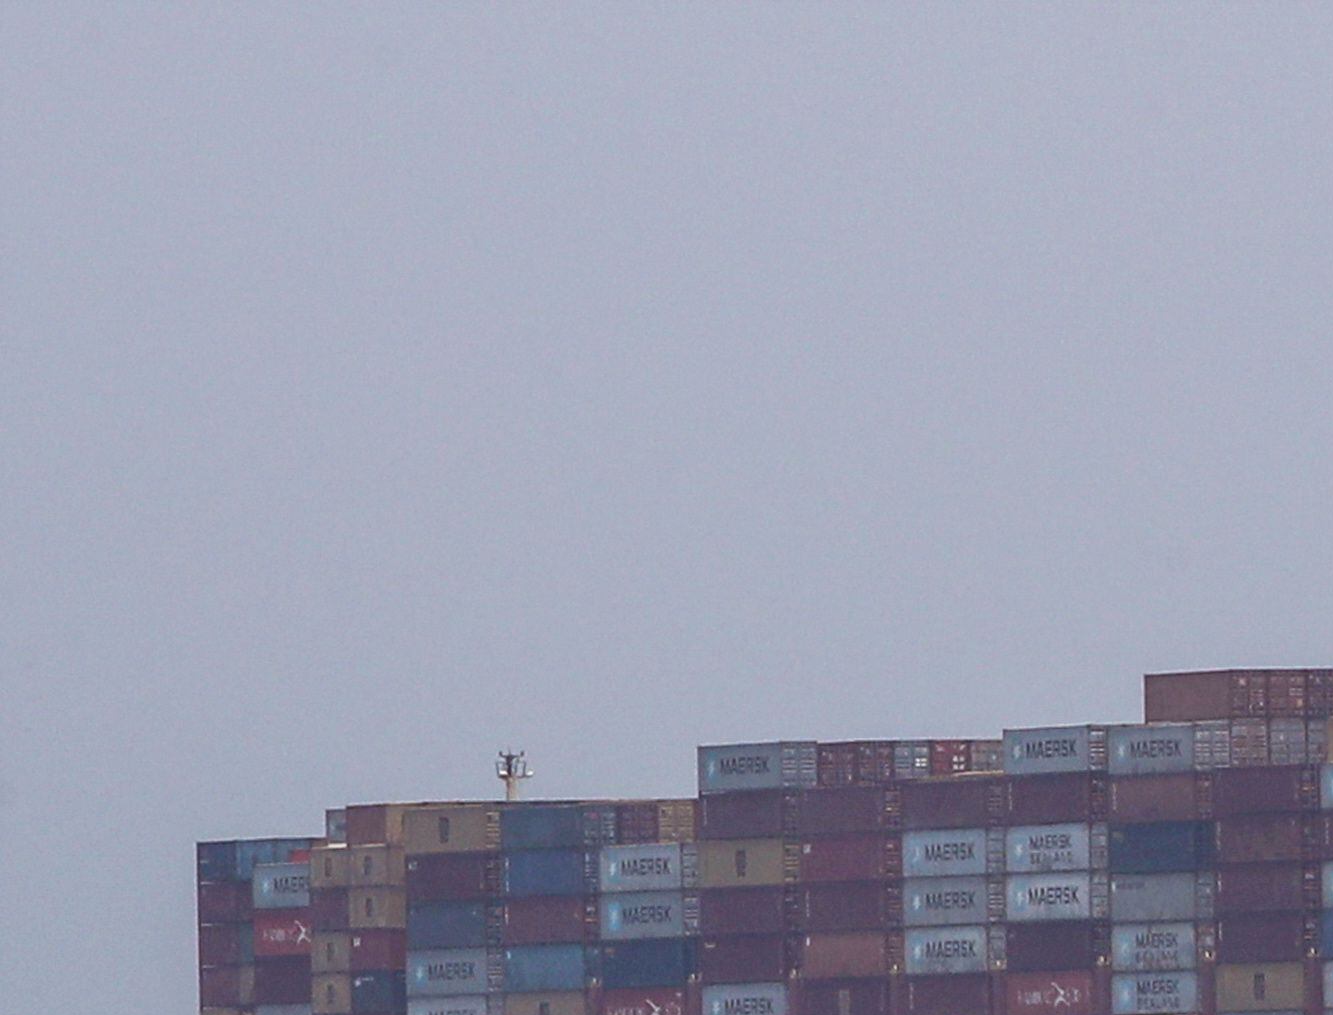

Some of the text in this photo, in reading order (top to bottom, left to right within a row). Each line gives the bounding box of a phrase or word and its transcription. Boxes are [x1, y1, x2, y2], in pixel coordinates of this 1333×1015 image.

[1026, 741, 1077, 758] MAERSK
[1130, 740, 1181, 757] MAERSK
[721, 757, 769, 775] MAERSK
[1029, 835, 1071, 849] MAERSK
[925, 844, 975, 861] MAERSK
[621, 859, 670, 877] MAERSK
[926, 892, 975, 910] MAERSK
[1029, 886, 1078, 905] MAERSK
[623, 907, 671, 924] MAERSK
[1136, 933, 1178, 948] MAERSK
[926, 941, 976, 958] MAERSK
[428, 964, 475, 980] MAERSK
[1137, 979, 1179, 996] MAERSK
[725, 998, 773, 1015] MAERSK
